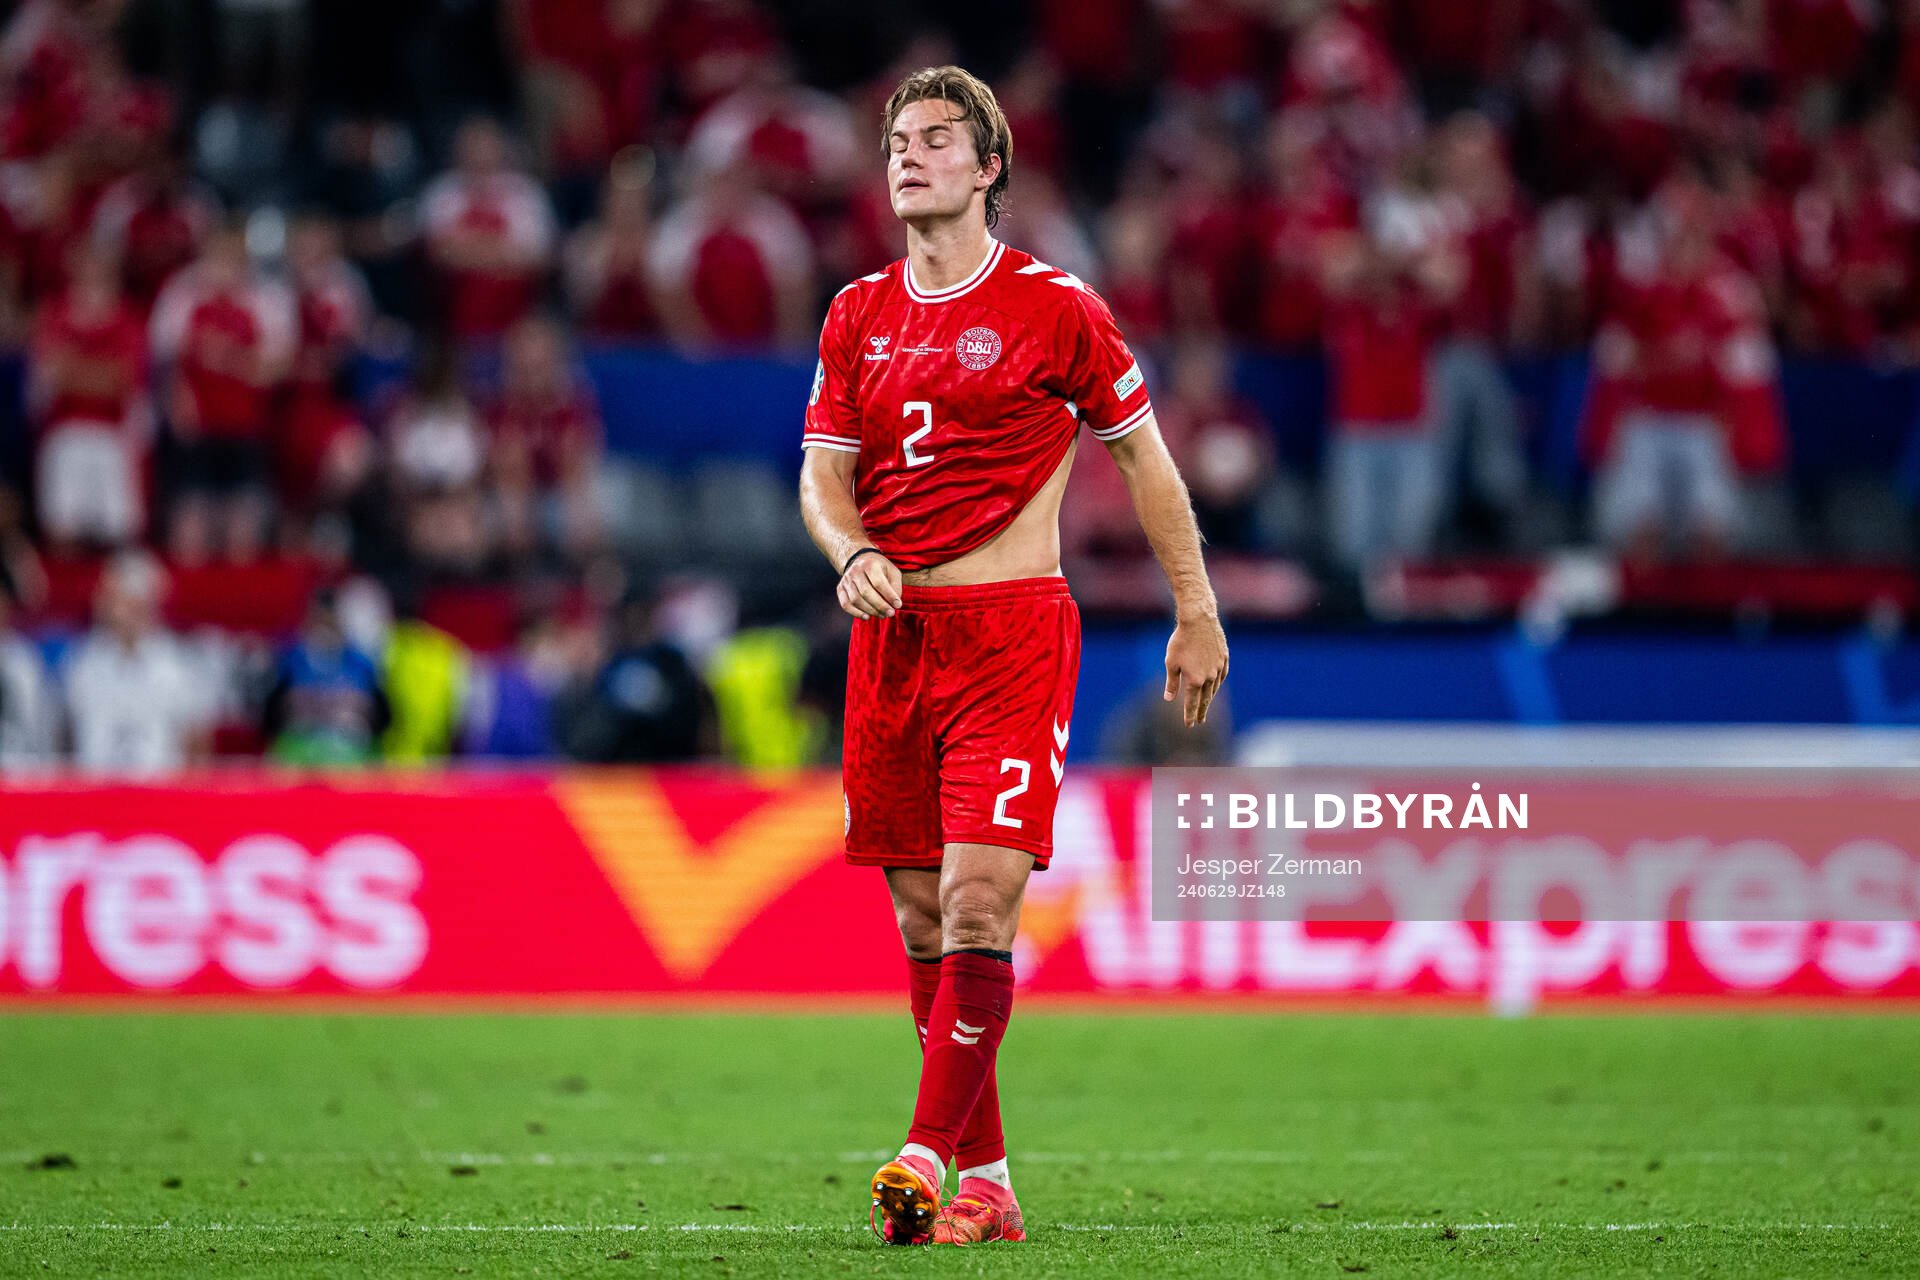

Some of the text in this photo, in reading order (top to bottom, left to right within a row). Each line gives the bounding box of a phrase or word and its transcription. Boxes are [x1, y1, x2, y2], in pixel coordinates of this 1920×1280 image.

[966, 341, 993, 355] DBU
[903, 401, 935, 468] 2
[992, 757, 1031, 829] 2
[0, 832, 429, 988] ress
